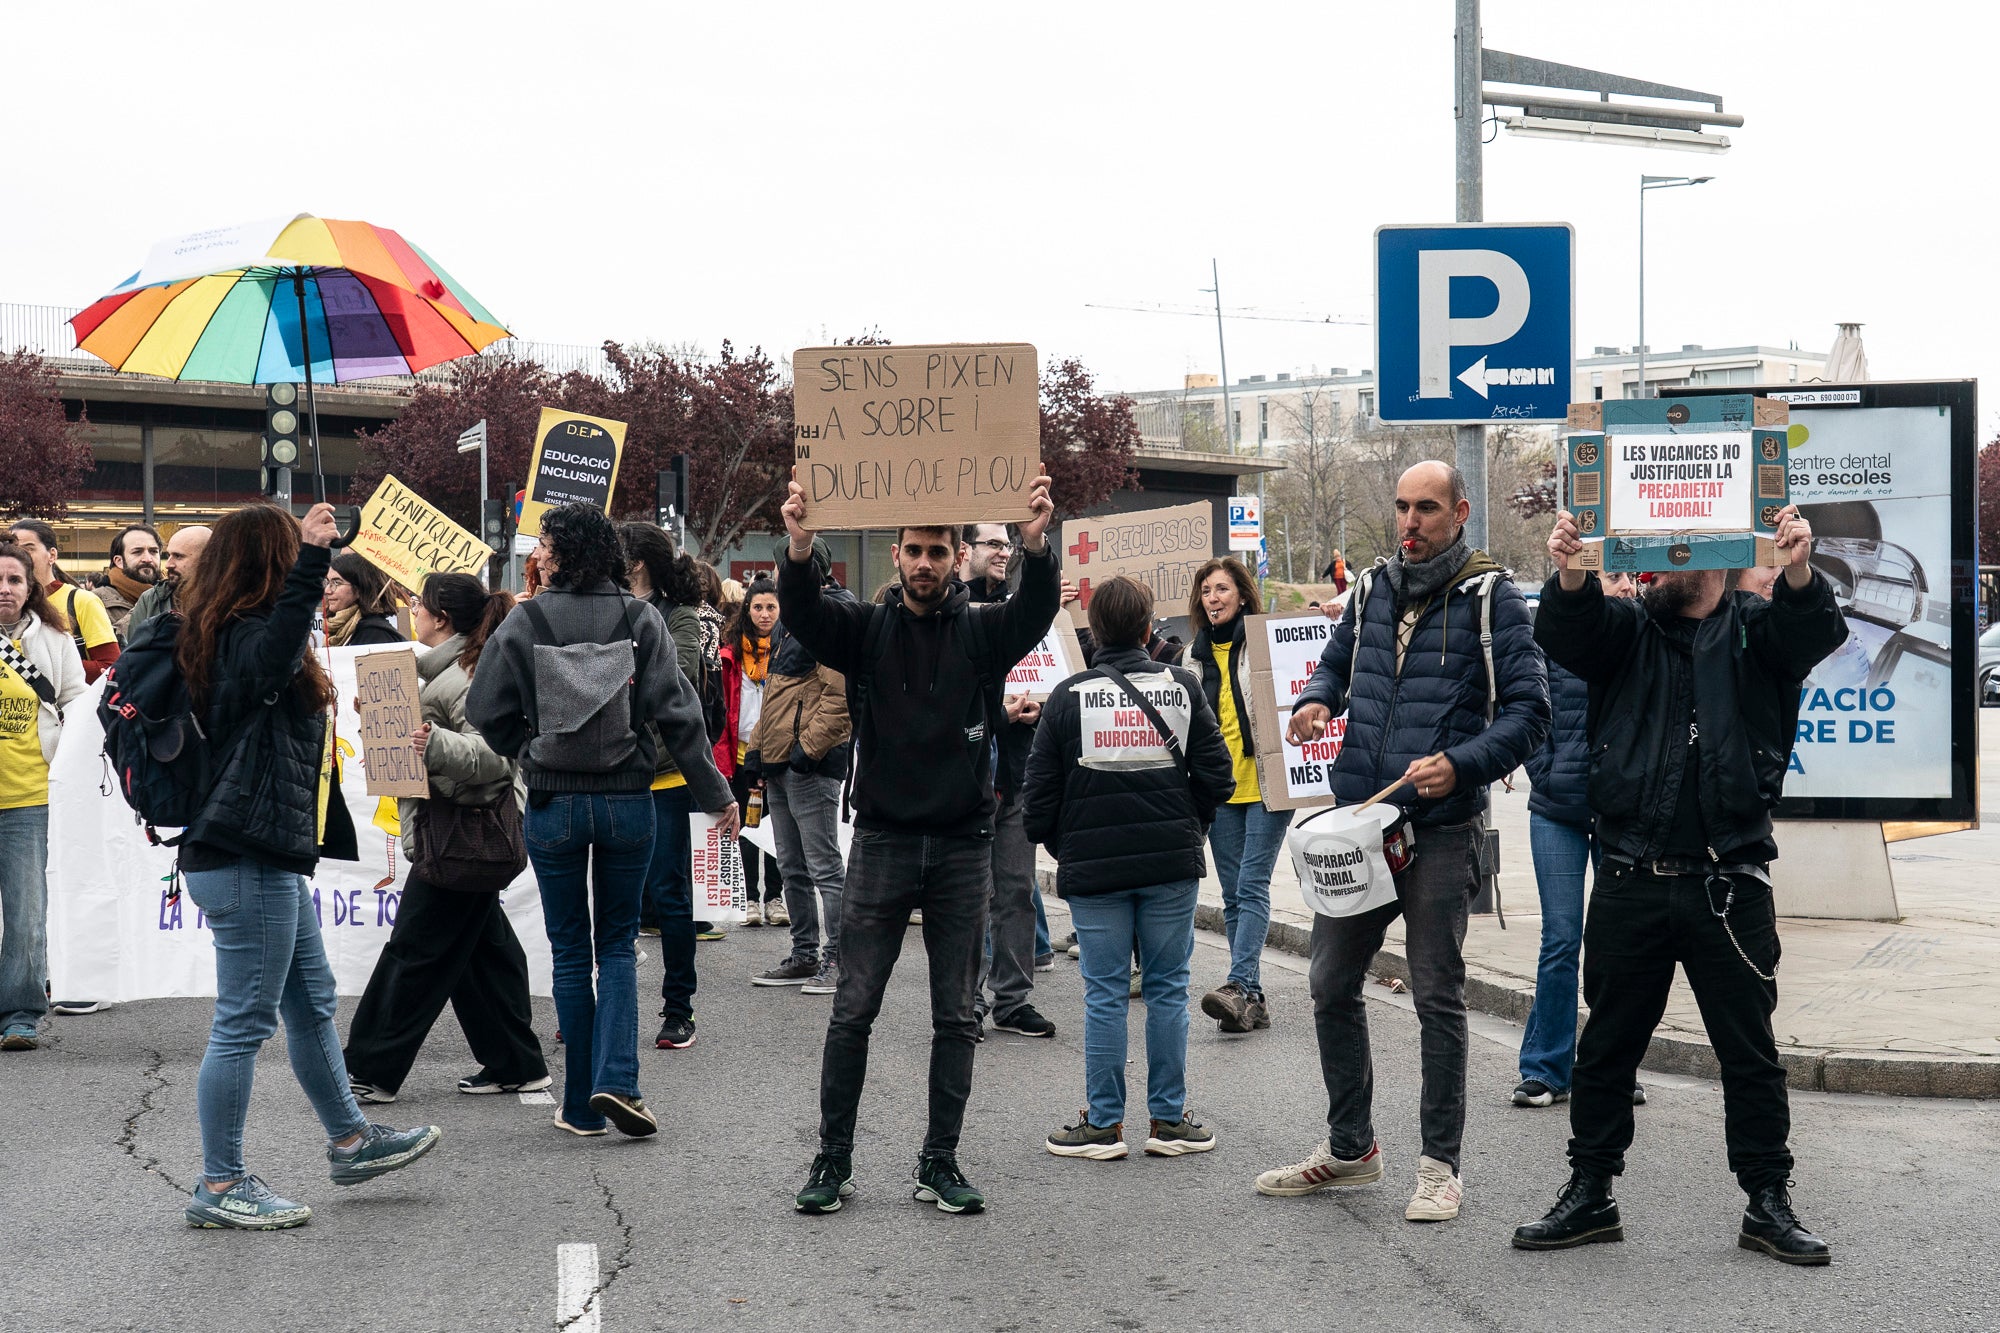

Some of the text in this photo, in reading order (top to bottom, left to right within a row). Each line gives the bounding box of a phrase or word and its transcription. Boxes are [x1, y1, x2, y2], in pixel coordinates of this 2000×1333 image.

[822, 406, 846, 441] A
[861, 396, 955, 437] SOBRE
[544, 449, 611, 470] EDUCACIÓ
[1587, 443, 1596, 463] ISO
[1623, 444, 1741, 462] LES VACANCES NO
[1840, 452, 1891, 470] dental
[540, 464, 607, 486] INCLUSIVA
[811, 455, 1027, 503] DIUEN QUE PLOU
[1630, 463, 1732, 480] JUSTIFIQUEN LA
[1817, 469, 1892, 486] escoles
[546, 490, 568, 499] DECRET
[1638, 482, 1724, 499] PRECARIETAT
[1807, 490, 1824, 498] per
[544, 497, 562, 506] SENSE
[1650, 501, 1712, 518] LABORAL!
[1102, 516, 1208, 562] RECURSOS
[1275, 624, 1327, 644] DOCENTS
[1043, 654, 1056, 666] DE
[1085, 688, 1187, 709] MÉS EDCACIÓ,
[1114, 710, 1161, 728] MEN
[1094, 727, 1174, 748] BUROCRÀC
[1848, 720, 1896, 744] DE
[1290, 762, 1323, 786] MÉS
[706, 828, 718, 871] VOSTRES
[694, 849, 705, 884] FILLES!
[732, 856, 740, 893] MANCA
[707, 874, 718, 900] FILLS
[720, 888, 730, 906] ELS
[1330, 882, 1368, 896] PROFESSORAT
[159, 890, 182, 930] LA
[334, 889, 364, 927] DE
[732, 896, 740, 910] DE
